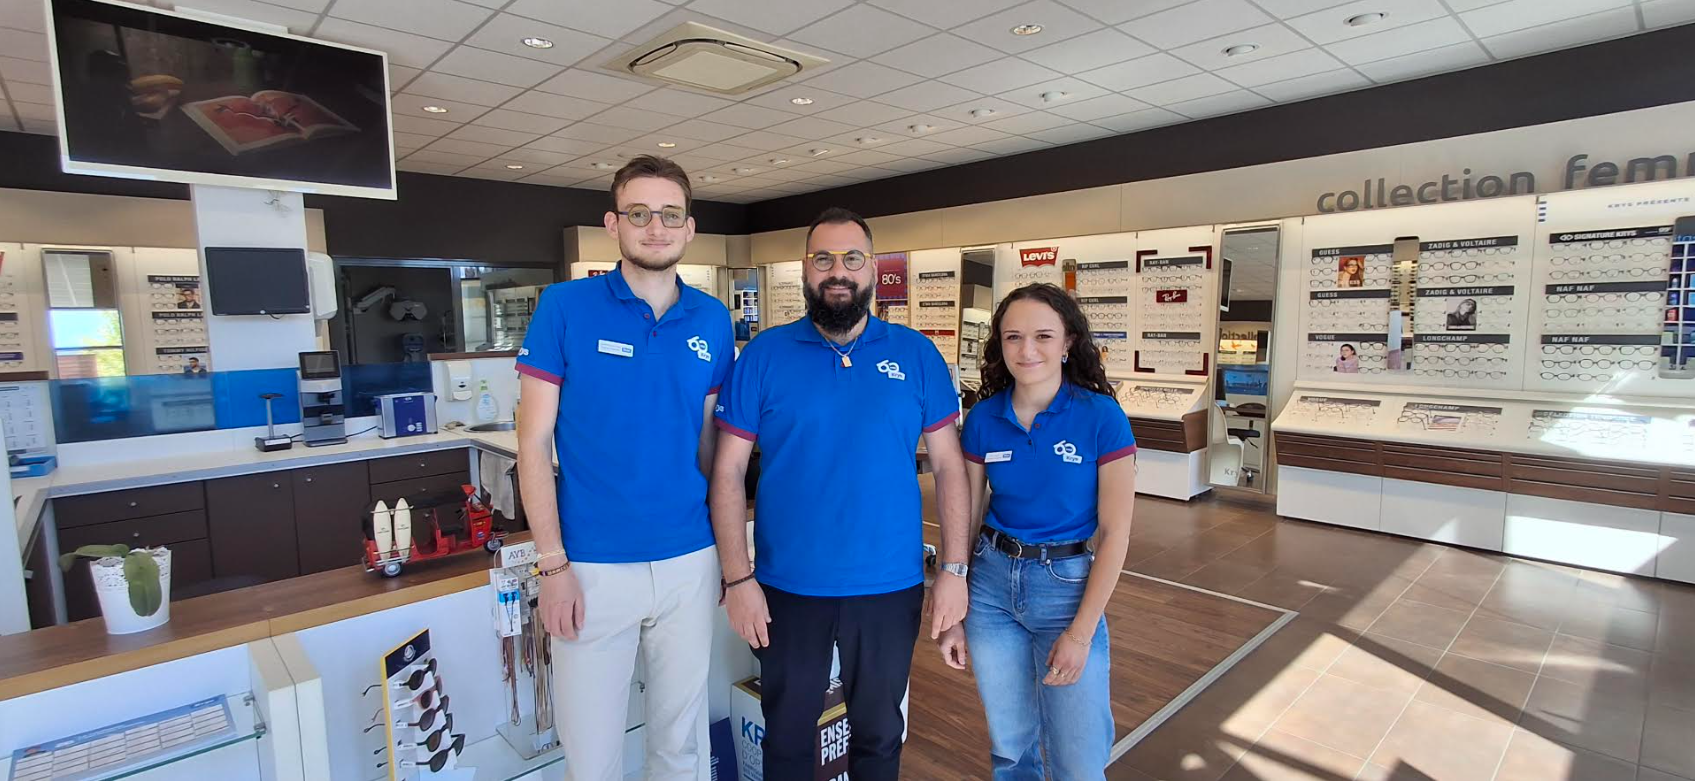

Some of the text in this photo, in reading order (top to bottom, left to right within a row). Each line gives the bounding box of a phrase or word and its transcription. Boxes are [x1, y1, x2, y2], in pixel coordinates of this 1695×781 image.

[1316, 168, 1536, 213] collection
[1460, 239, 1498, 248] VOLTAIRE
[881, 273, 902, 285] 80's
